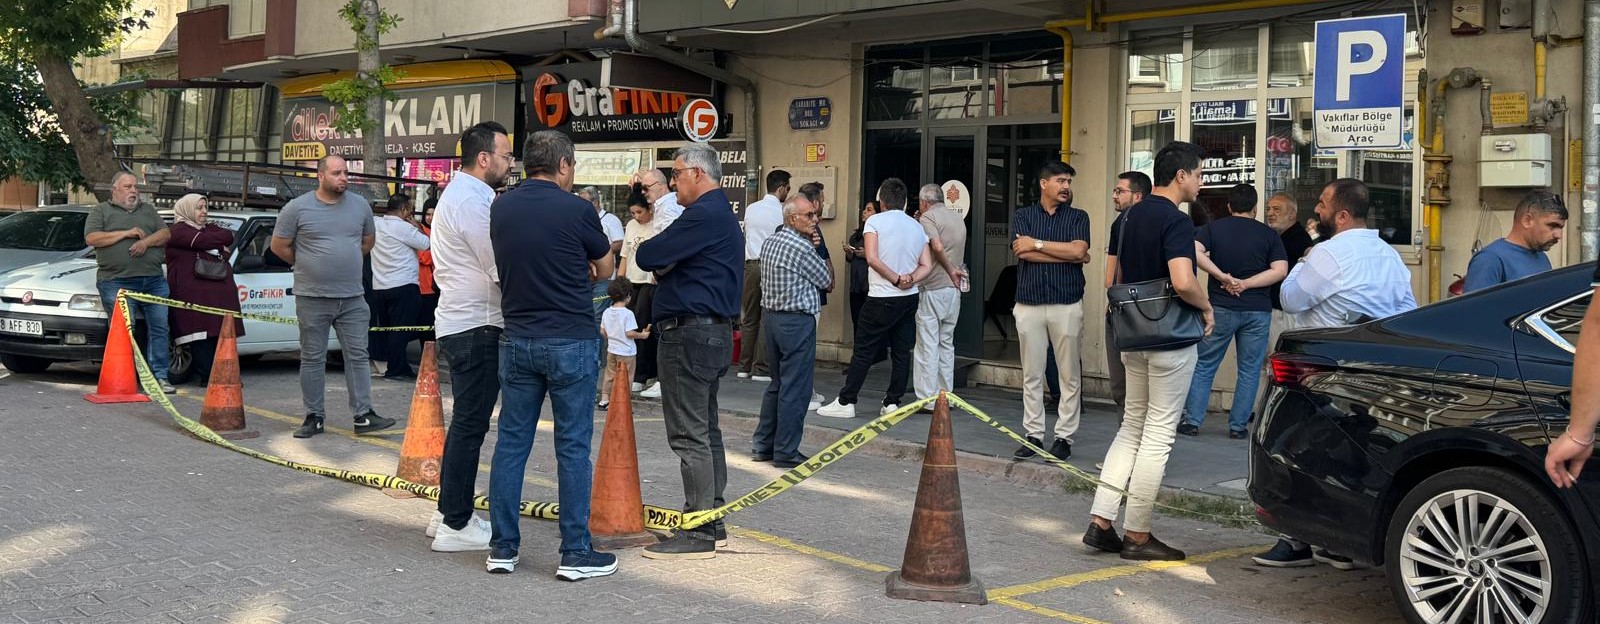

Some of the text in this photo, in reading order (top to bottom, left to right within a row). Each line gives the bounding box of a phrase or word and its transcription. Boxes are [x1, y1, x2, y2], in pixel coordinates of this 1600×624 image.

[1336, 30, 1388, 101] P
[1322, 111, 1392, 122] Vakıflar Bölge
[571, 117, 679, 132] REKLAM PROMOSYON MAT
[1331, 123, 1385, 133] Müdürlüğü
[1347, 134, 1374, 144] Araç
[285, 145, 319, 157] DAVETİYE
[412, 143, 436, 155] KAŞE
[719, 151, 746, 163] BELA
[9, 320, 22, 331] AFF
[26, 321, 40, 333] 830
